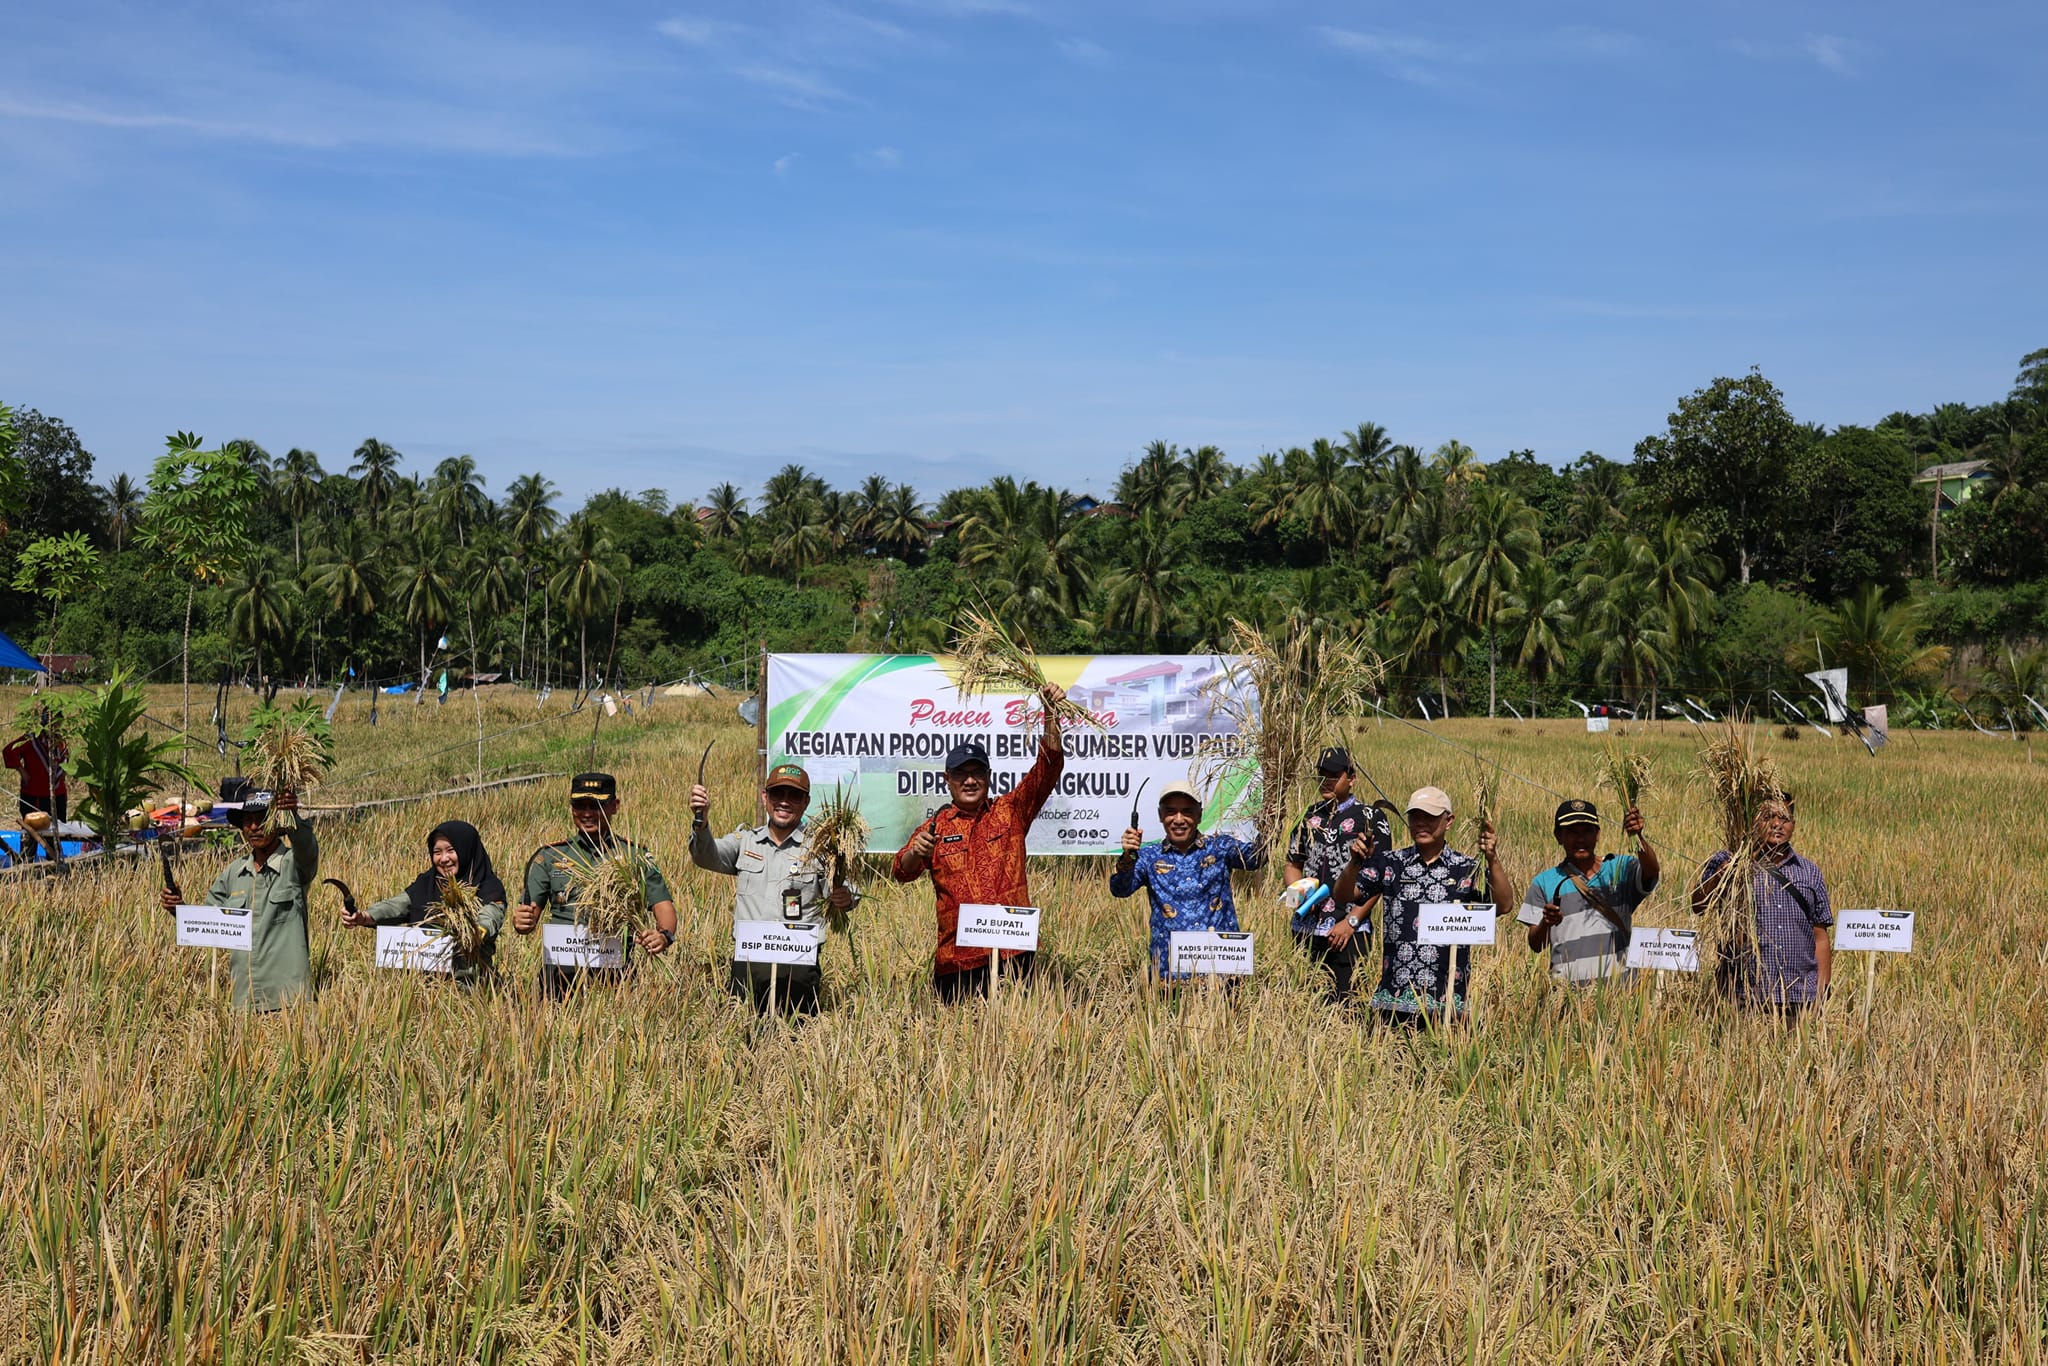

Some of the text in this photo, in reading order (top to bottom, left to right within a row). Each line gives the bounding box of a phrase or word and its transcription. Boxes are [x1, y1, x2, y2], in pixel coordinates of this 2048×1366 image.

[909, 698, 1120, 728] Panen Berama
[785, 732, 885, 758] KEGIATAN
[996, 733, 1043, 759] BEN
[1062, 734, 1148, 760] SUMBER
[1151, 734, 1195, 759] VUB
[897, 771, 1131, 798] DI PRNSI NGKULU
[1028, 808, 1100, 820] ktober 2024
[1077, 840, 1105, 848] Bengkulu
[976, 918, 1023, 929] PJ BUPATI
[1878, 923, 1901, 931] DESA
[220, 929, 242, 937] DALAM
[964, 927, 1030, 937] BENGKULU TENGAH
[566, 937, 601, 946] DANDM
[763, 934, 791, 942] KEPALA
[551, 945, 585, 954] BENGKULU
[741, 941, 812, 953] BSIP BENGKULU
[1203, 945, 1247, 953] PERTANIAN
[1639, 941, 1692, 951] KETUA POKTAN
